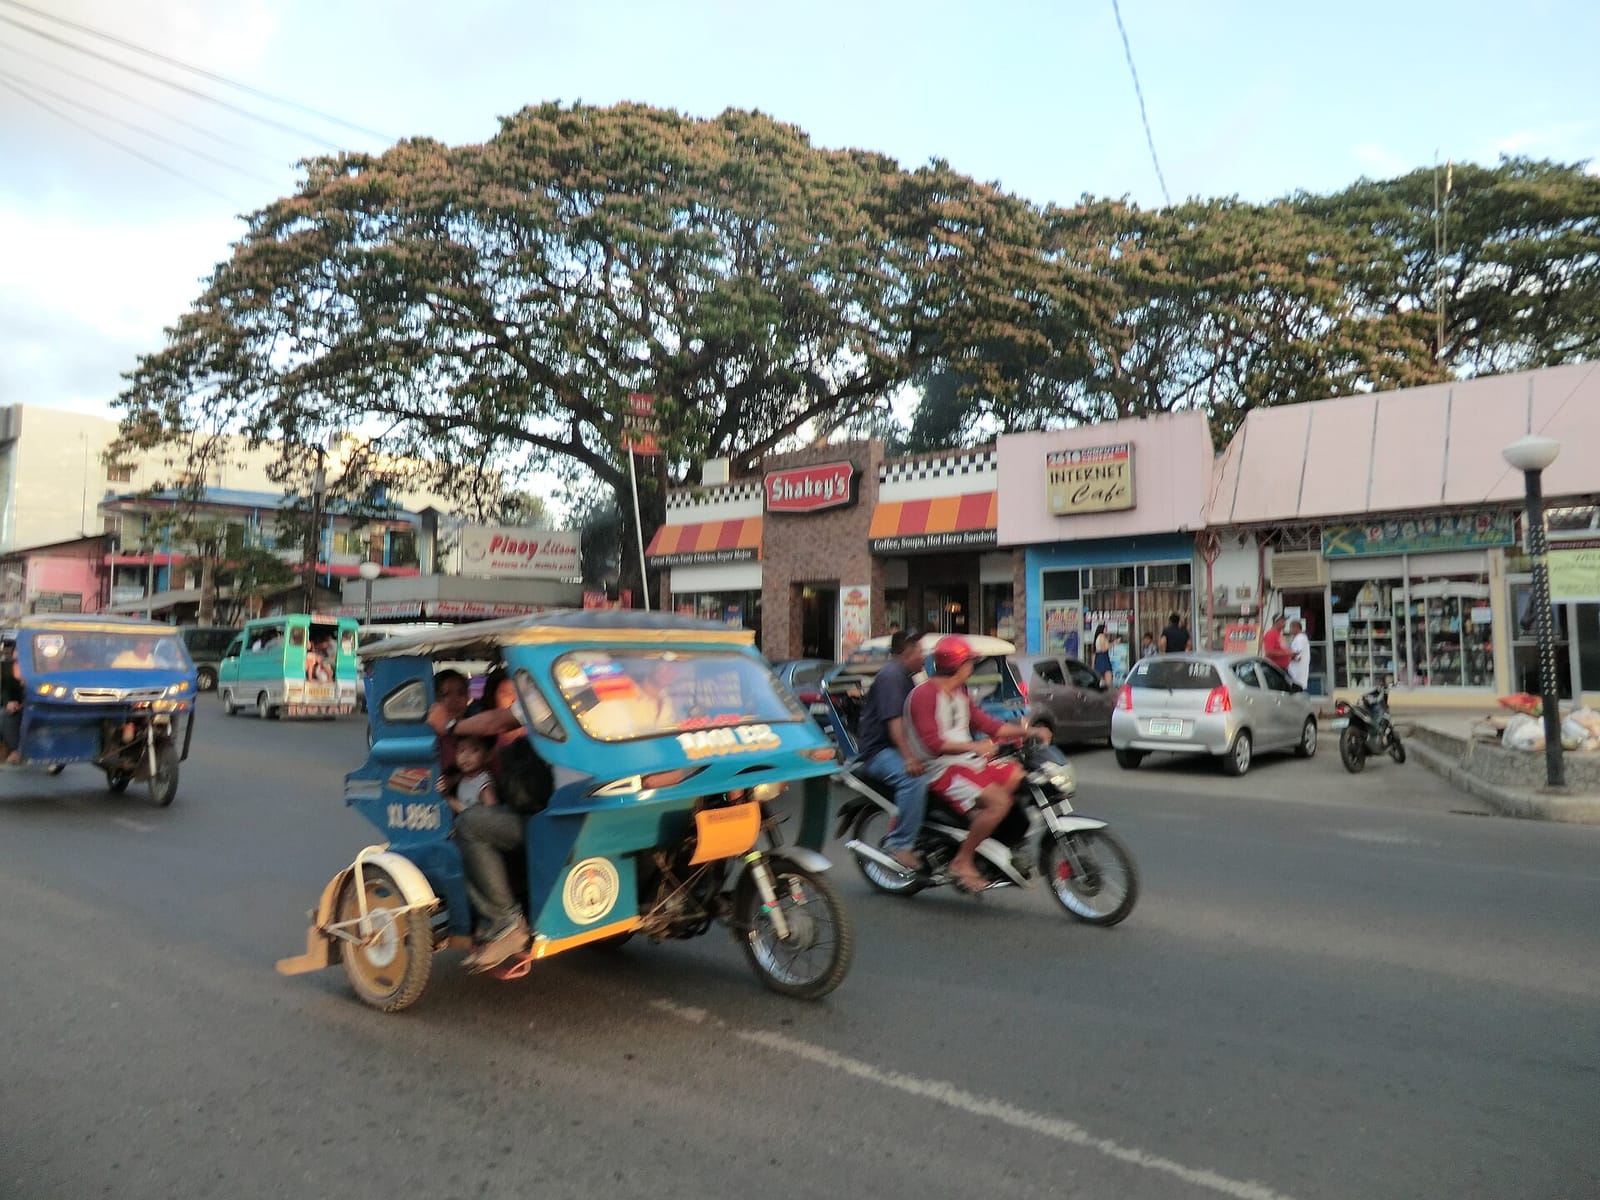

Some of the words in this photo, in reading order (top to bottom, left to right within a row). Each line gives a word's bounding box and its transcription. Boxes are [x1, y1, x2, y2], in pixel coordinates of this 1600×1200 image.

[1051, 463, 1125, 485] INTERNET
[772, 471, 845, 502] Shakey's
[489, 534, 539, 561] Pinoy
[927, 535, 941, 547] Hot
[943, 534, 961, 545] Hero
